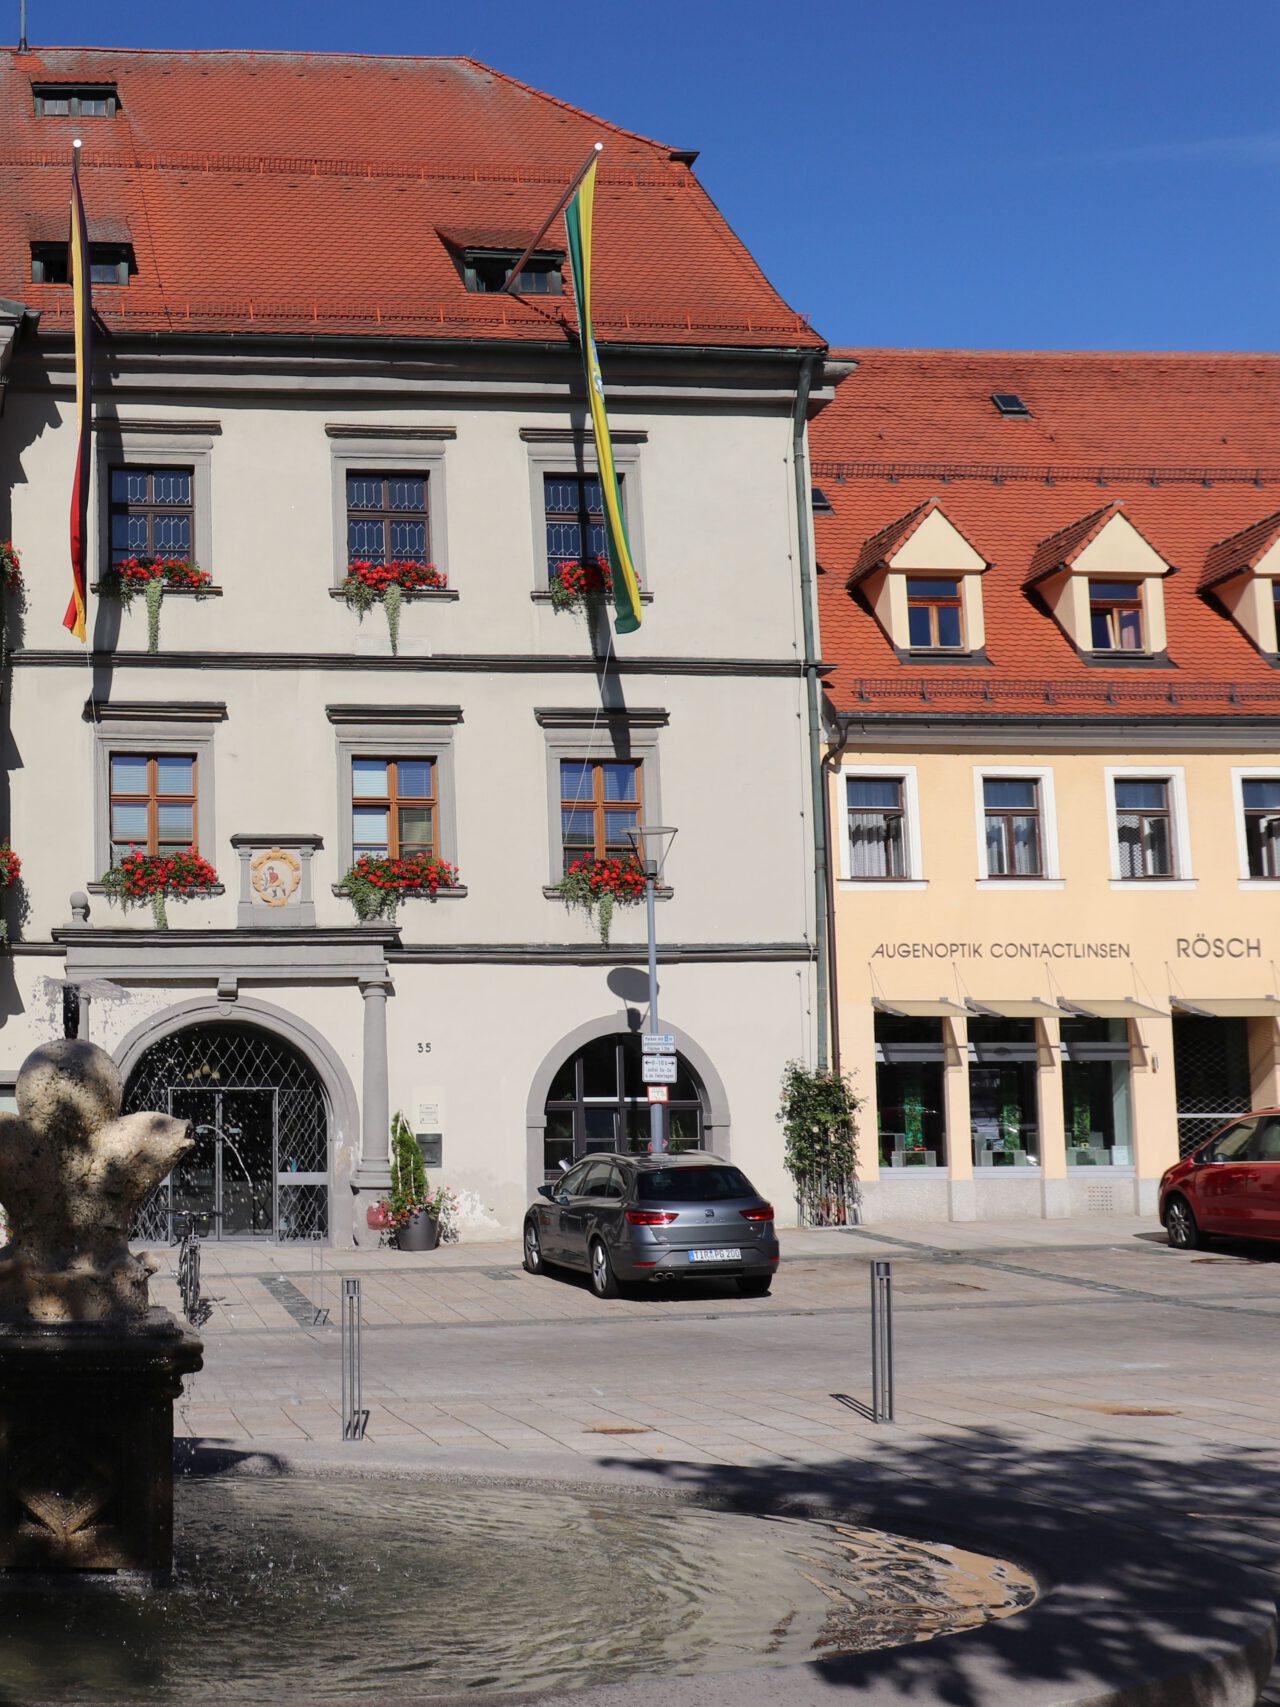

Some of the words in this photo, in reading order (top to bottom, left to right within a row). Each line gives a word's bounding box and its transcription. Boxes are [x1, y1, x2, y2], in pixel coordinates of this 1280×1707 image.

[871, 942, 983, 958] AUGENOPTIK
[990, 942, 1130, 958] CONTACTLINSEN
[1176, 933, 1261, 958] RÖSCH
[417, 1042, 432, 1053] 35
